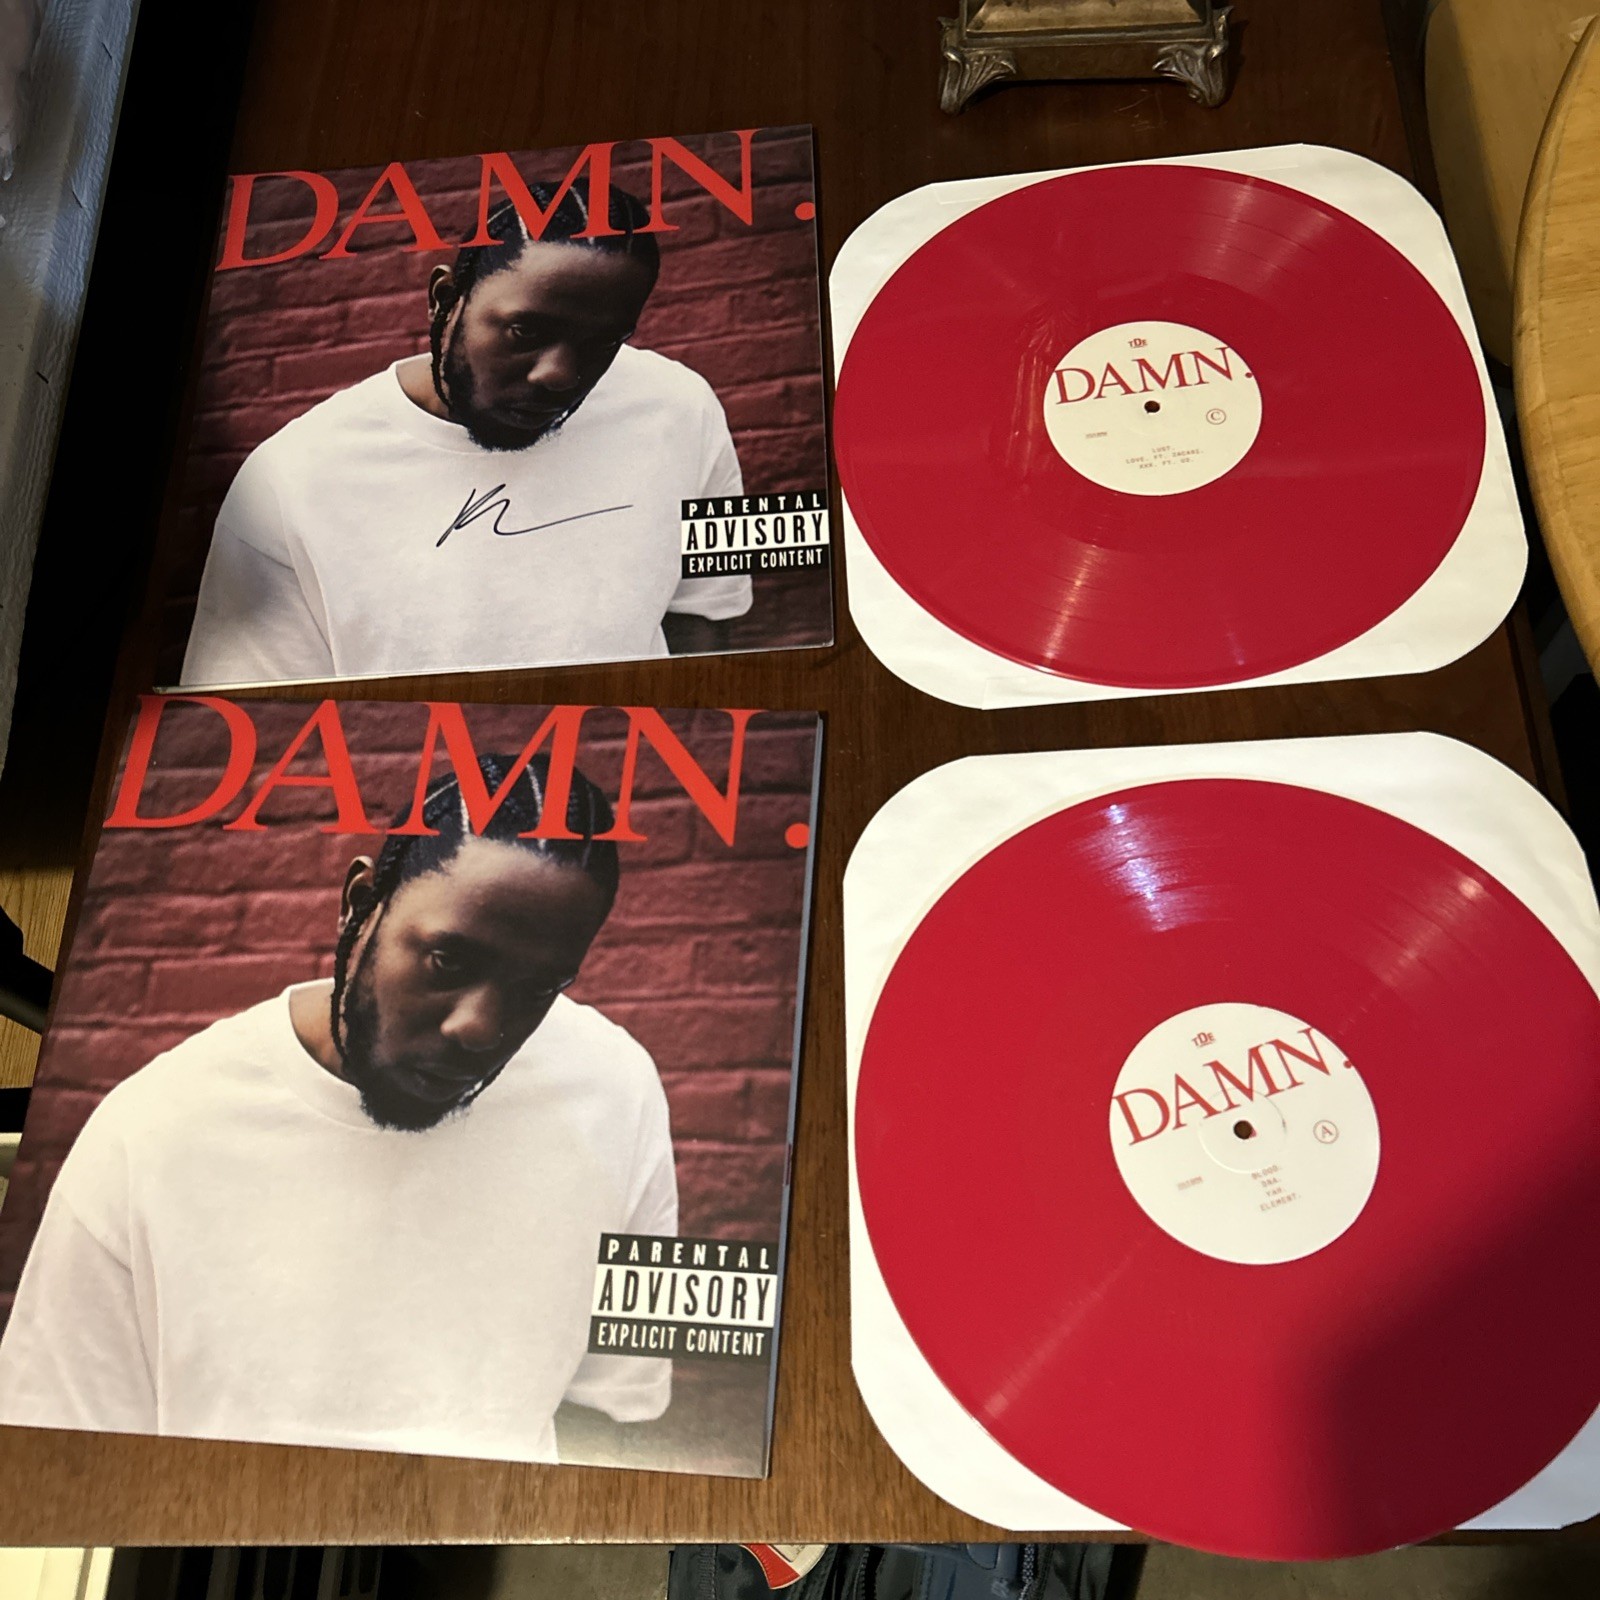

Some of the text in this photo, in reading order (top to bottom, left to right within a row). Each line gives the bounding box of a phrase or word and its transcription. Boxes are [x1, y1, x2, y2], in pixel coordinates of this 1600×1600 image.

[214, 129, 816, 272] DAMN.
[1128, 338, 1148, 348] TDE
[1055, 346, 1253, 405] DAMN.
[688, 493, 821, 517] PARENTAL
[686, 512, 823, 551] ADVISORY
[689, 548, 823, 573] EXPLICIT CONTENT
[102, 695, 811, 849] DAMN.
[1191, 1031, 1216, 1047] TDE
[1112, 1027, 1353, 1146] DAMN.
[607, 1239, 770, 1270] PARENTAL
[597, 1268, 771, 1321] ADVISORY
[597, 1322, 765, 1357] EXPLICIT CONTENT
